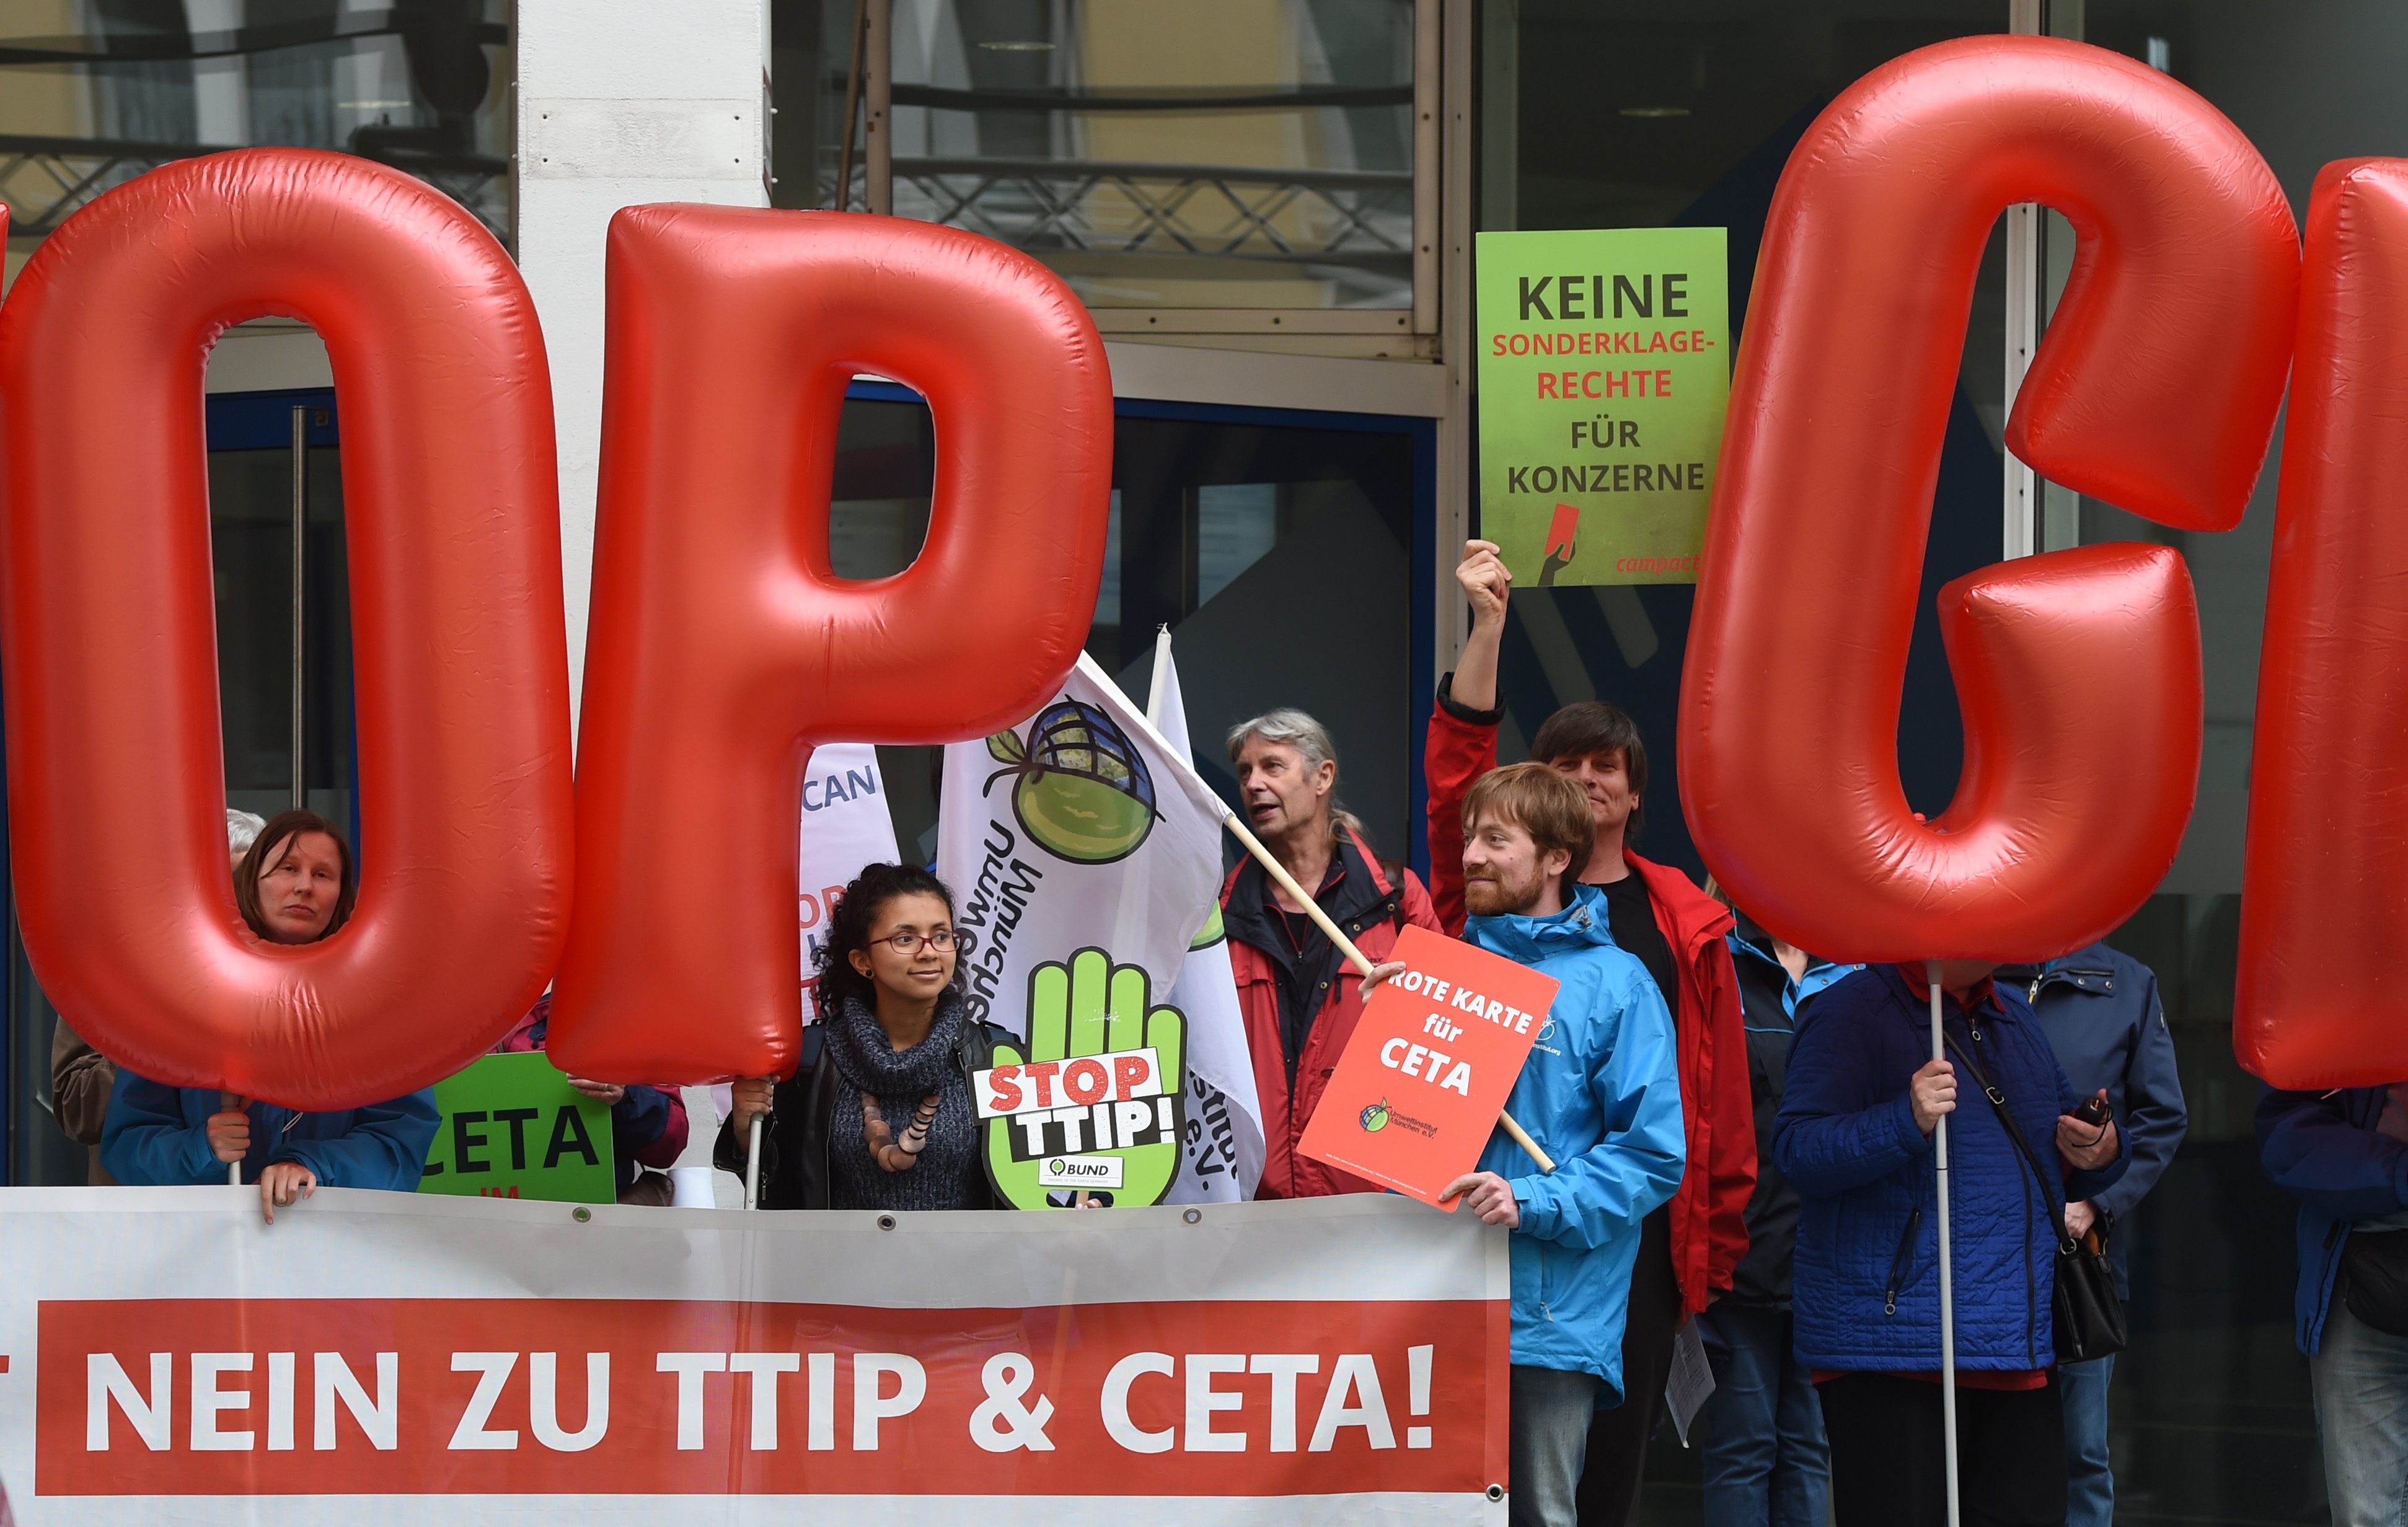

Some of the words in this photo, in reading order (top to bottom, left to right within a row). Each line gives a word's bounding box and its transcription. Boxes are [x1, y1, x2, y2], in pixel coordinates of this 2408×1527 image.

[1519, 273, 1688, 320] KEINE
[1493, 330, 1716, 356] SONDERKLAGE-
[1538, 369, 1672, 400] RECHTE
[1571, 413, 1641, 449] FÜR
[1509, 462, 1705, 494] KONZERNE
[0, 149, 1112, 1111] OP
[1388, 969, 1450, 1002] ROTE
[1450, 988, 1534, 1036] KARTE
[1422, 1013, 1463, 1042] für
[989, 1056, 1150, 1112] STOP
[1380, 1037, 1471, 1096] CETA
[1015, 1097, 1176, 1156] TTIP!
[1067, 1164, 1109, 1176] BUND
[86, 1352, 399, 1451] NEIN
[447, 1352, 611, 1452] ZU
[656, 1352, 927, 1451] TTIP
[969, 1352, 1056, 1453] &
[1100, 1344, 1434, 1454] CETA!
